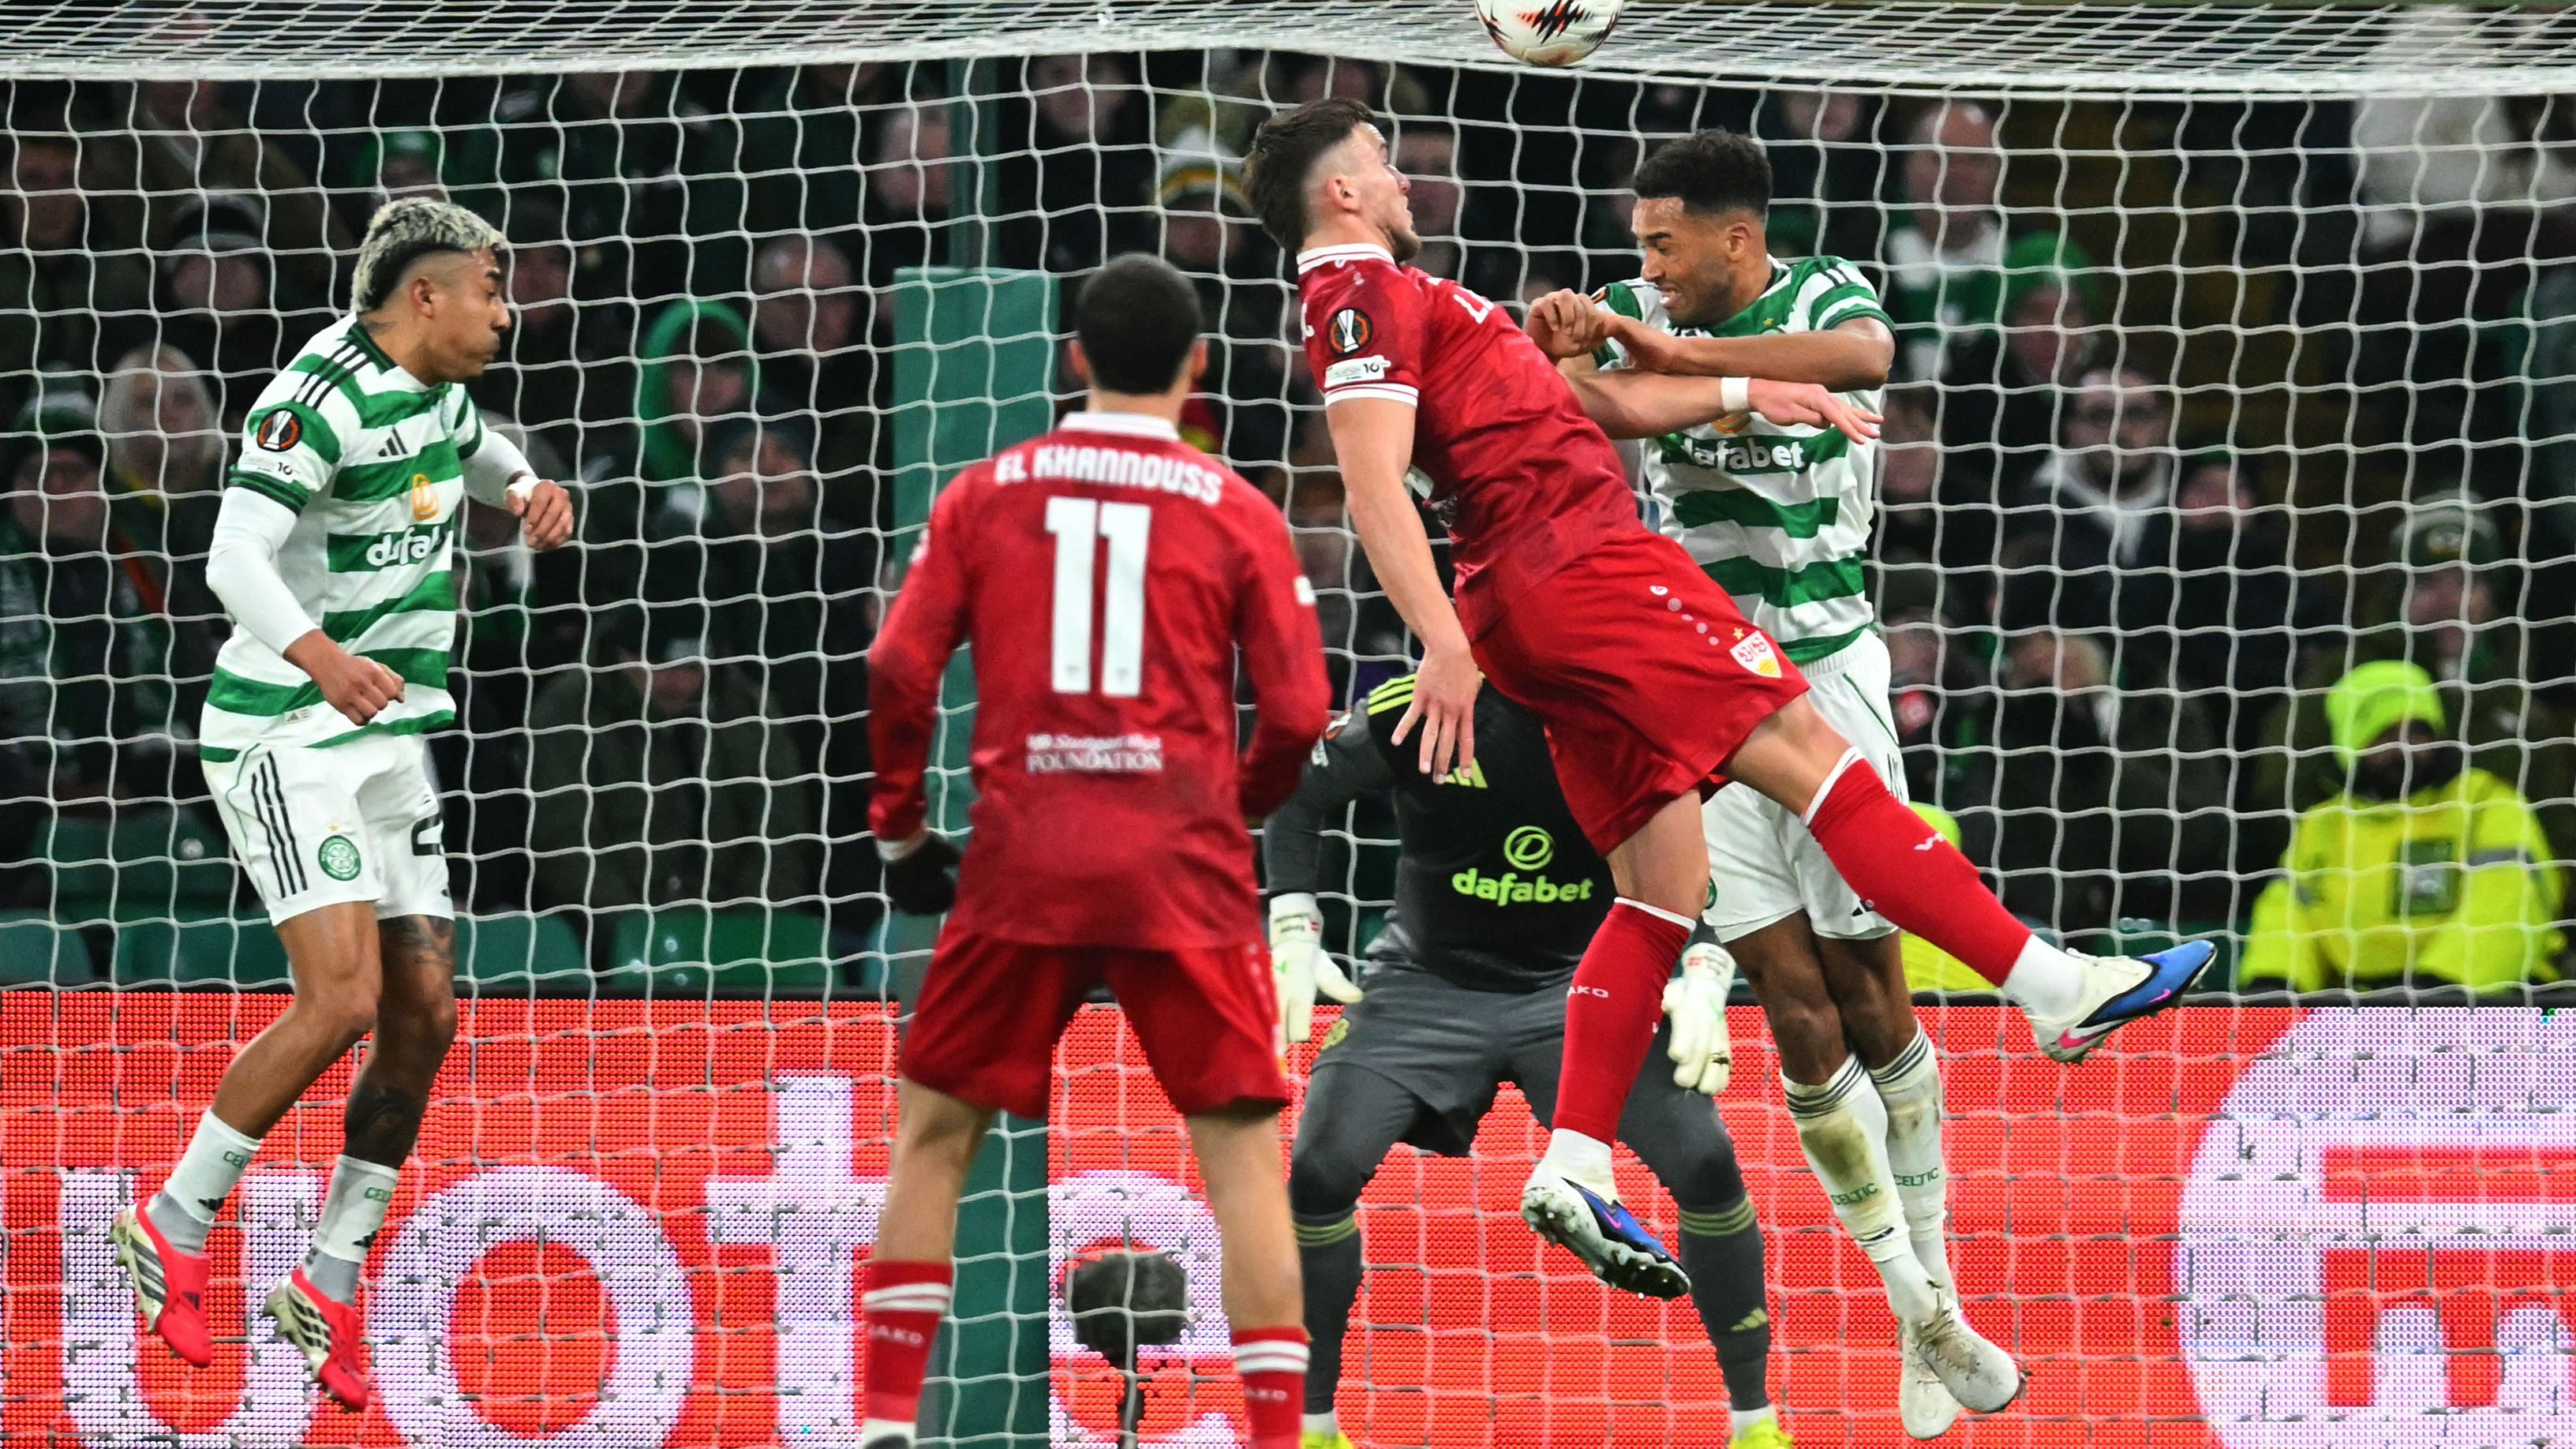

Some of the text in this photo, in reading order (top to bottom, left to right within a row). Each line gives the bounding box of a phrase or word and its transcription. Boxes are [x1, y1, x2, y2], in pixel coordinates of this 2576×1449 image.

[994, 444, 1223, 505] EL KHANNOUSS
[1045, 496, 1151, 698] 11
[1028, 751, 1163, 774] FOUNDATION
[1451, 868, 1594, 907] dafabet
[1567, 985, 1609, 998] AKO
[1894, 1167, 1939, 1186] CELTIC
[1830, 1182, 1878, 1205] CELTIC
